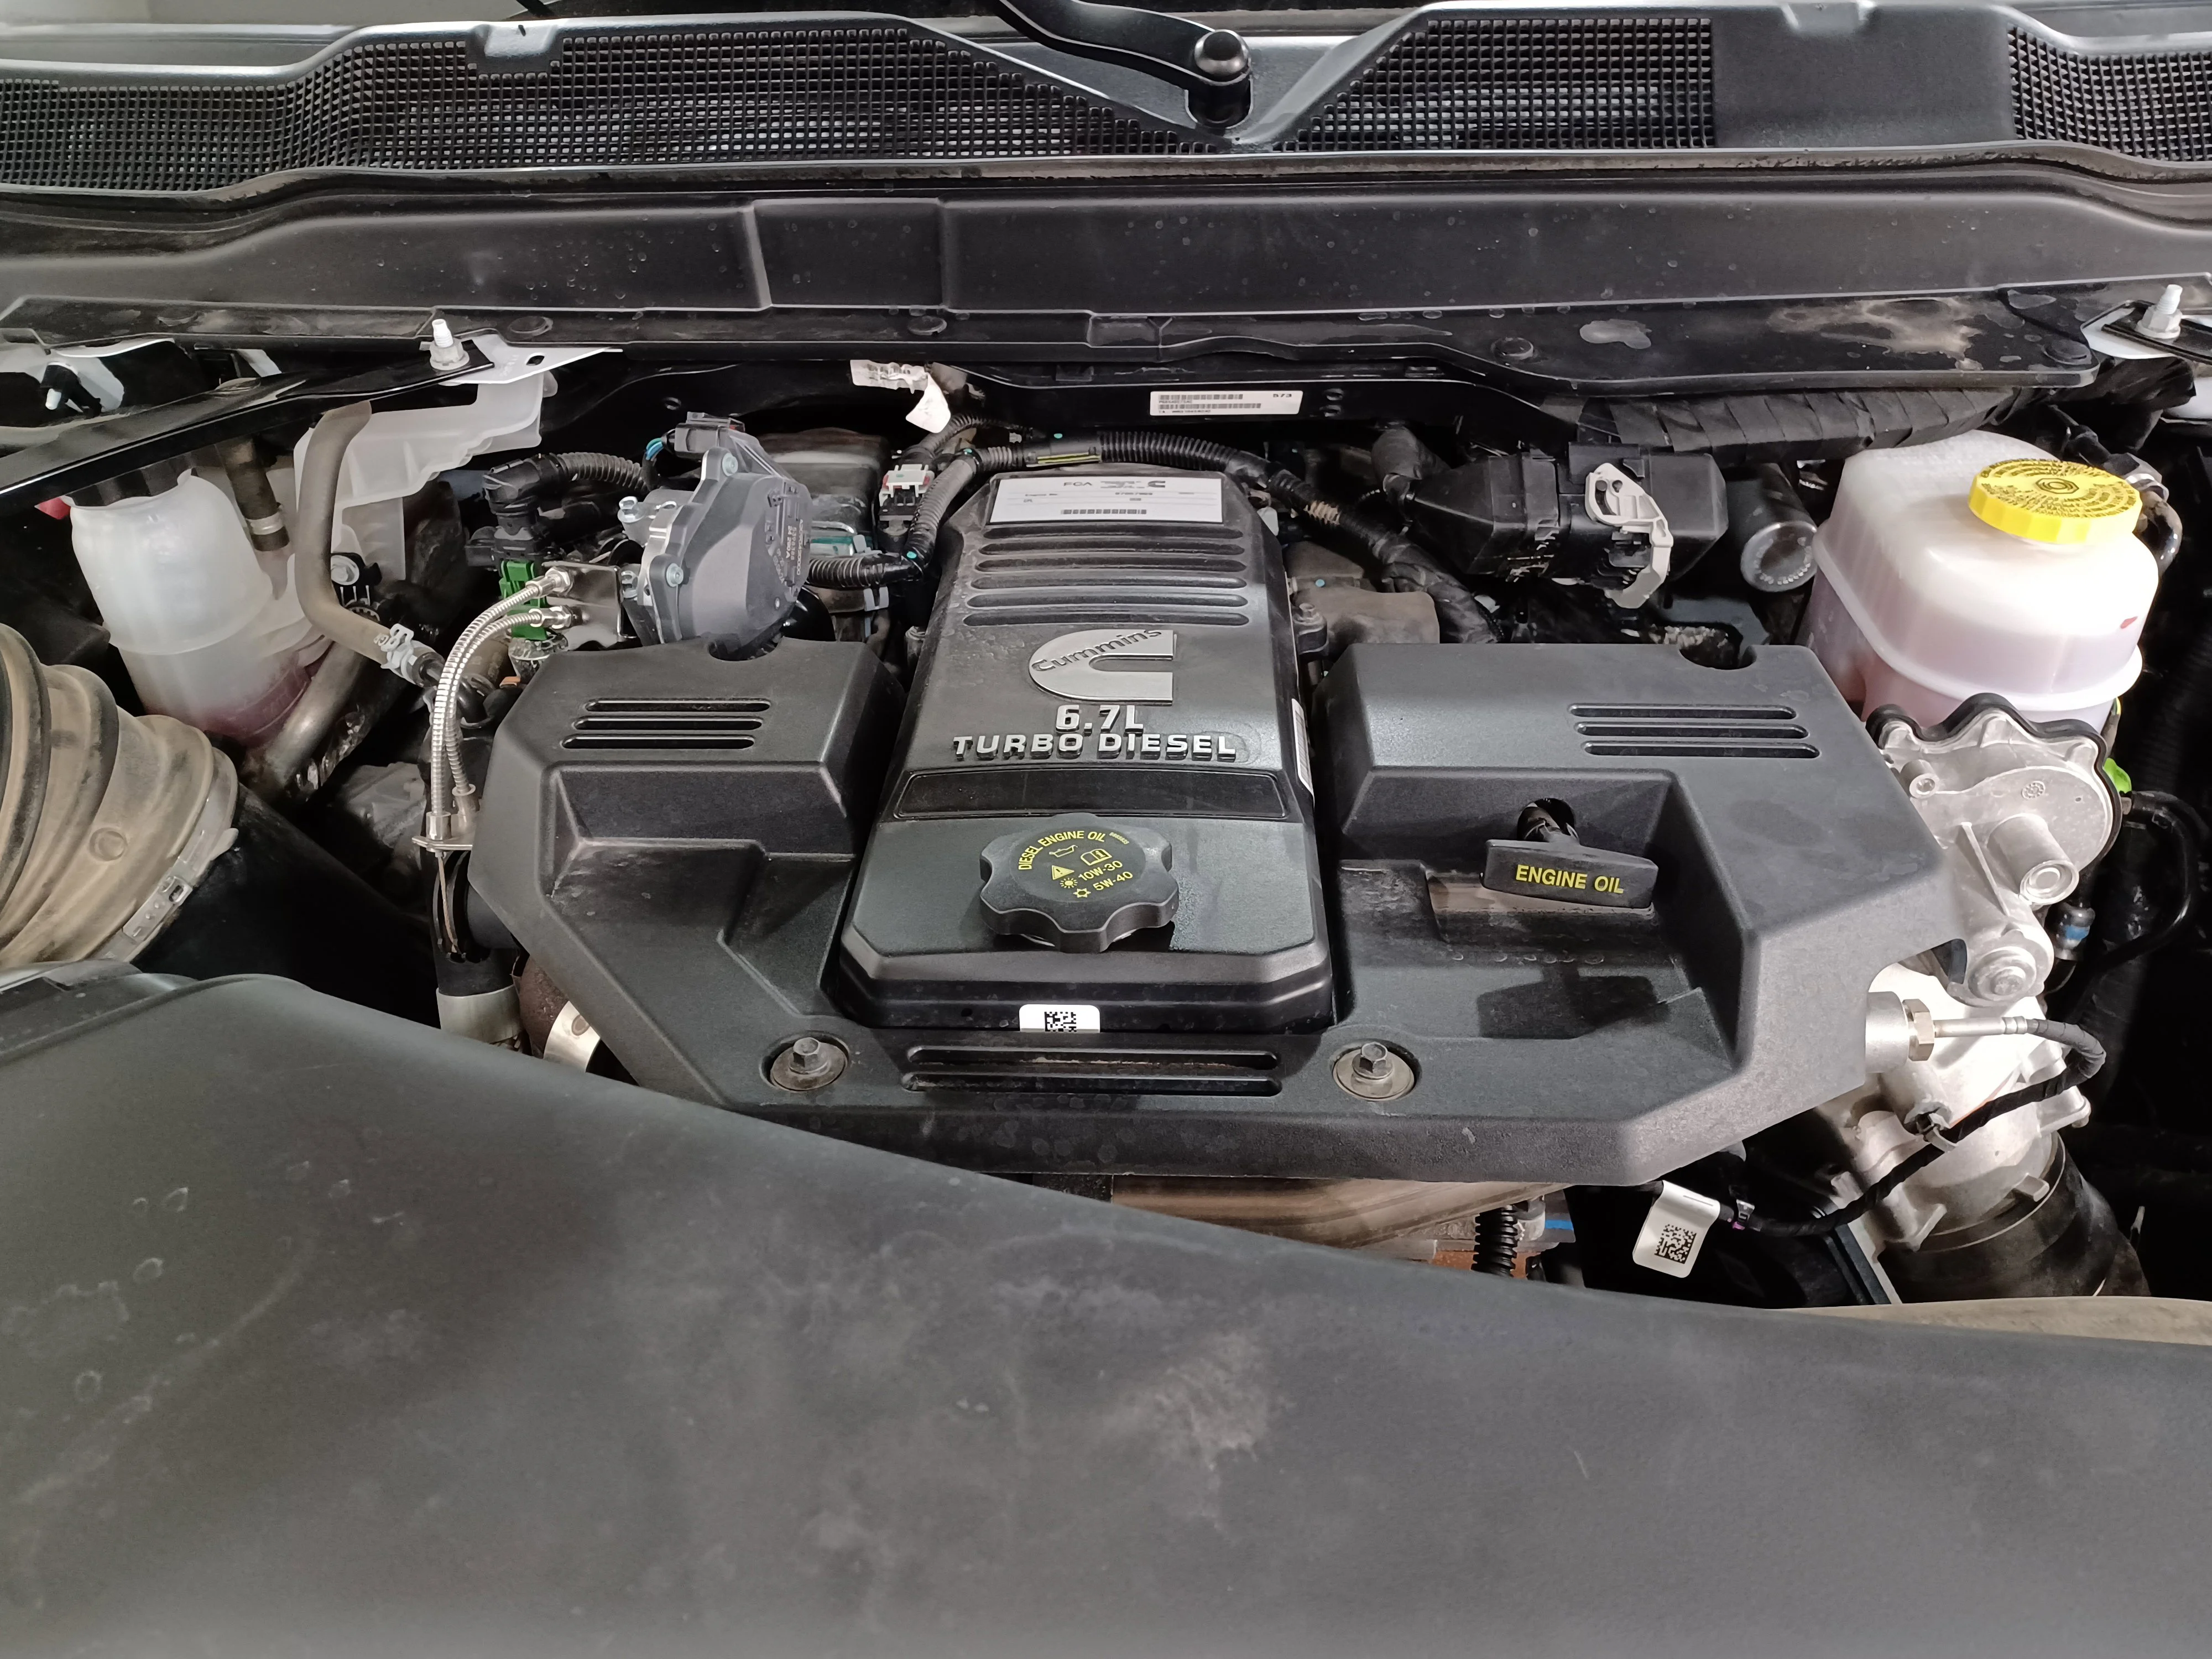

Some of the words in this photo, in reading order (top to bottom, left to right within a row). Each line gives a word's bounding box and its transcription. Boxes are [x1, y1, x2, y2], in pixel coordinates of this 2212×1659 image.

[1032, 629, 1162, 671] Cummins
[1056, 705, 1143, 734] 6.7L
[953, 733, 1083, 761] TURBO
[1097, 733, 1236, 763] DIESEL
[1018, 846, 1044, 870] DIESEL
[1038, 831, 1084, 847] ENGINE
[1087, 831, 1105, 842] OIL
[1078, 860, 1123, 881] 10W-30
[1093, 871, 1133, 891] 5W-40
[1516, 864, 1588, 889] ENGINE
[1594, 876, 1624, 894] OIL
